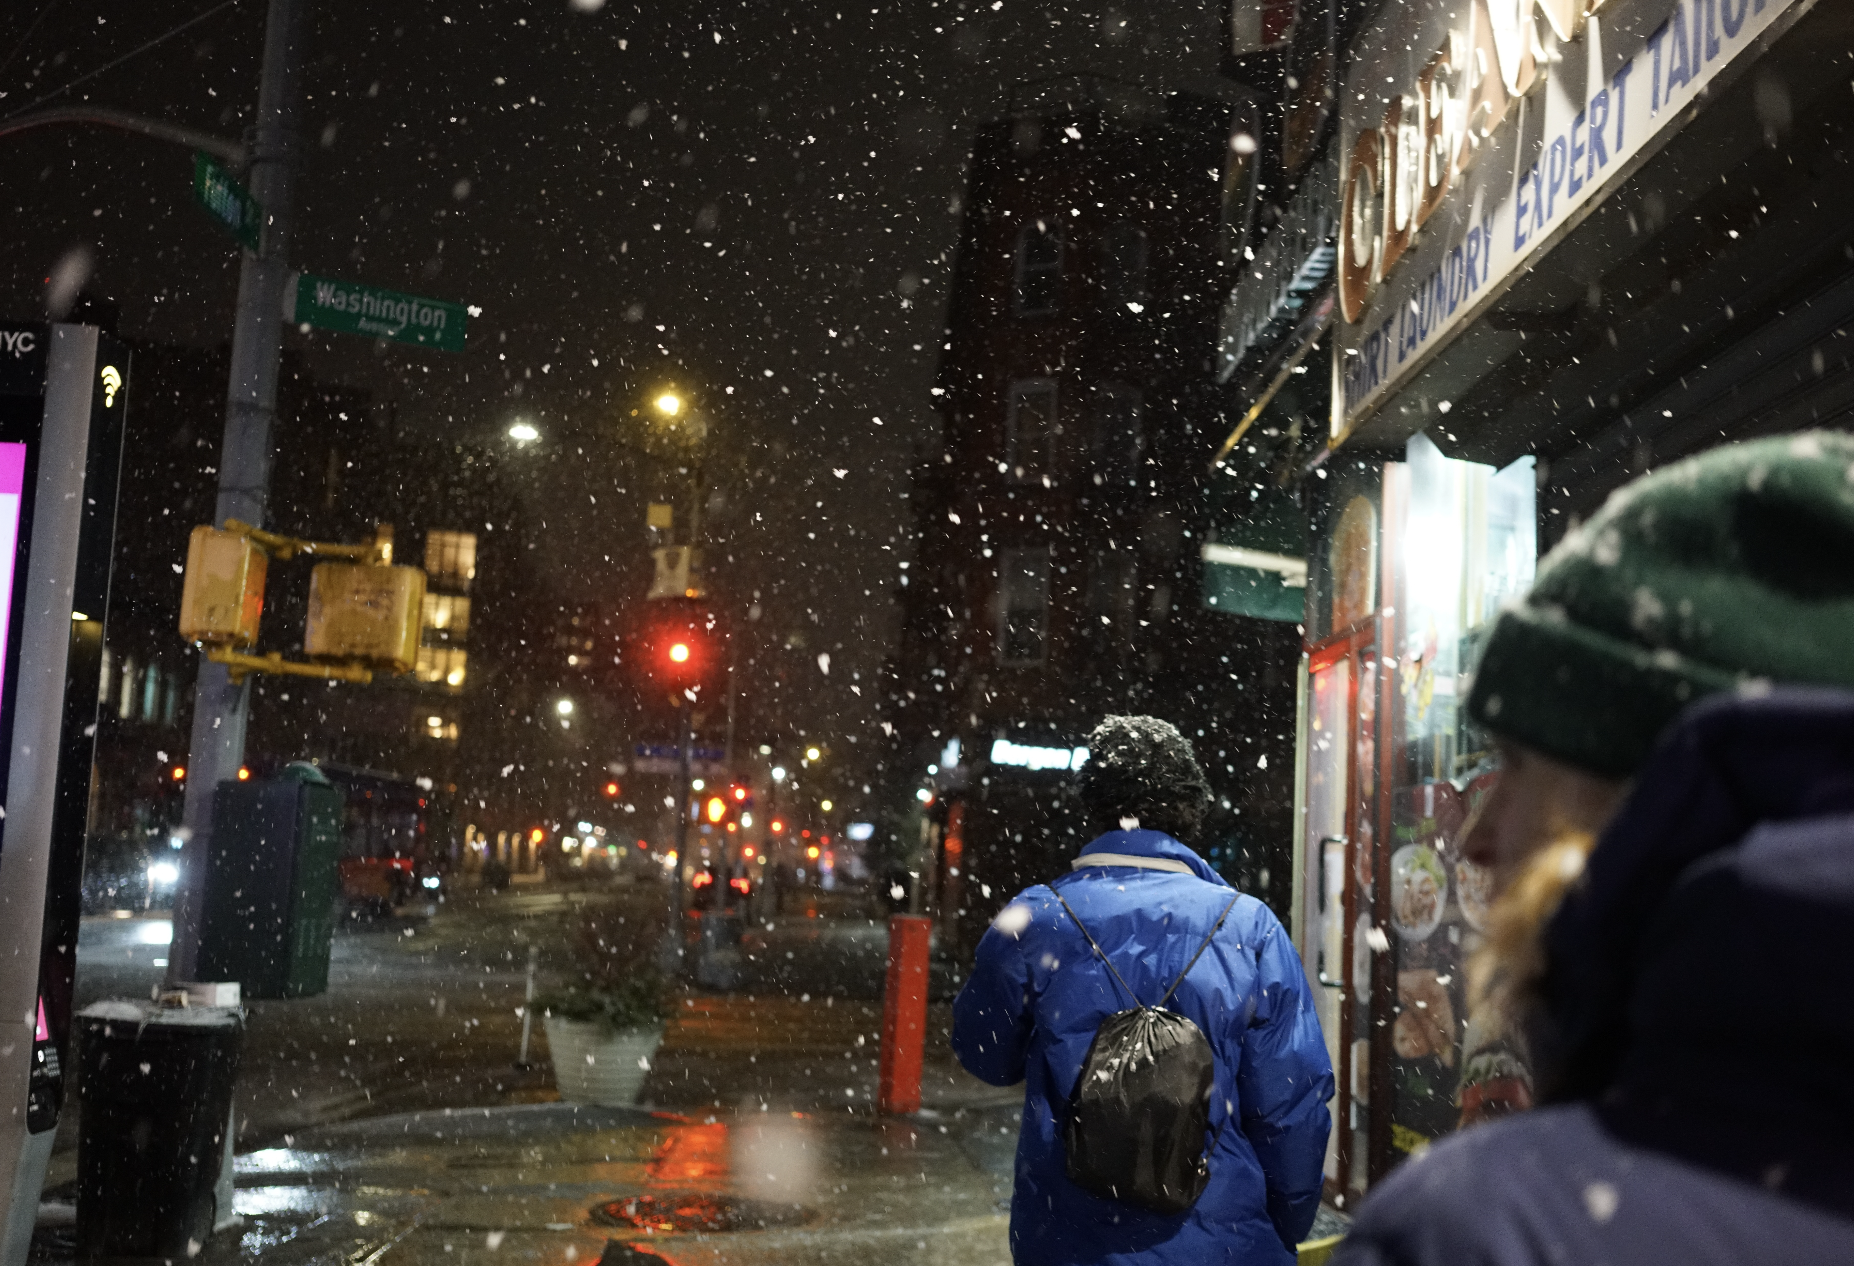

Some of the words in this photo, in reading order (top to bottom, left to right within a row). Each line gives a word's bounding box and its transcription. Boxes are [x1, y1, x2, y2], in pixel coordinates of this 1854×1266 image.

[1397, 204, 1496, 364] LAUNDRY
[1513, 56, 1635, 253] EXPERT
[315, 280, 447, 330] Washington
[0, 330, 36, 353] YC
